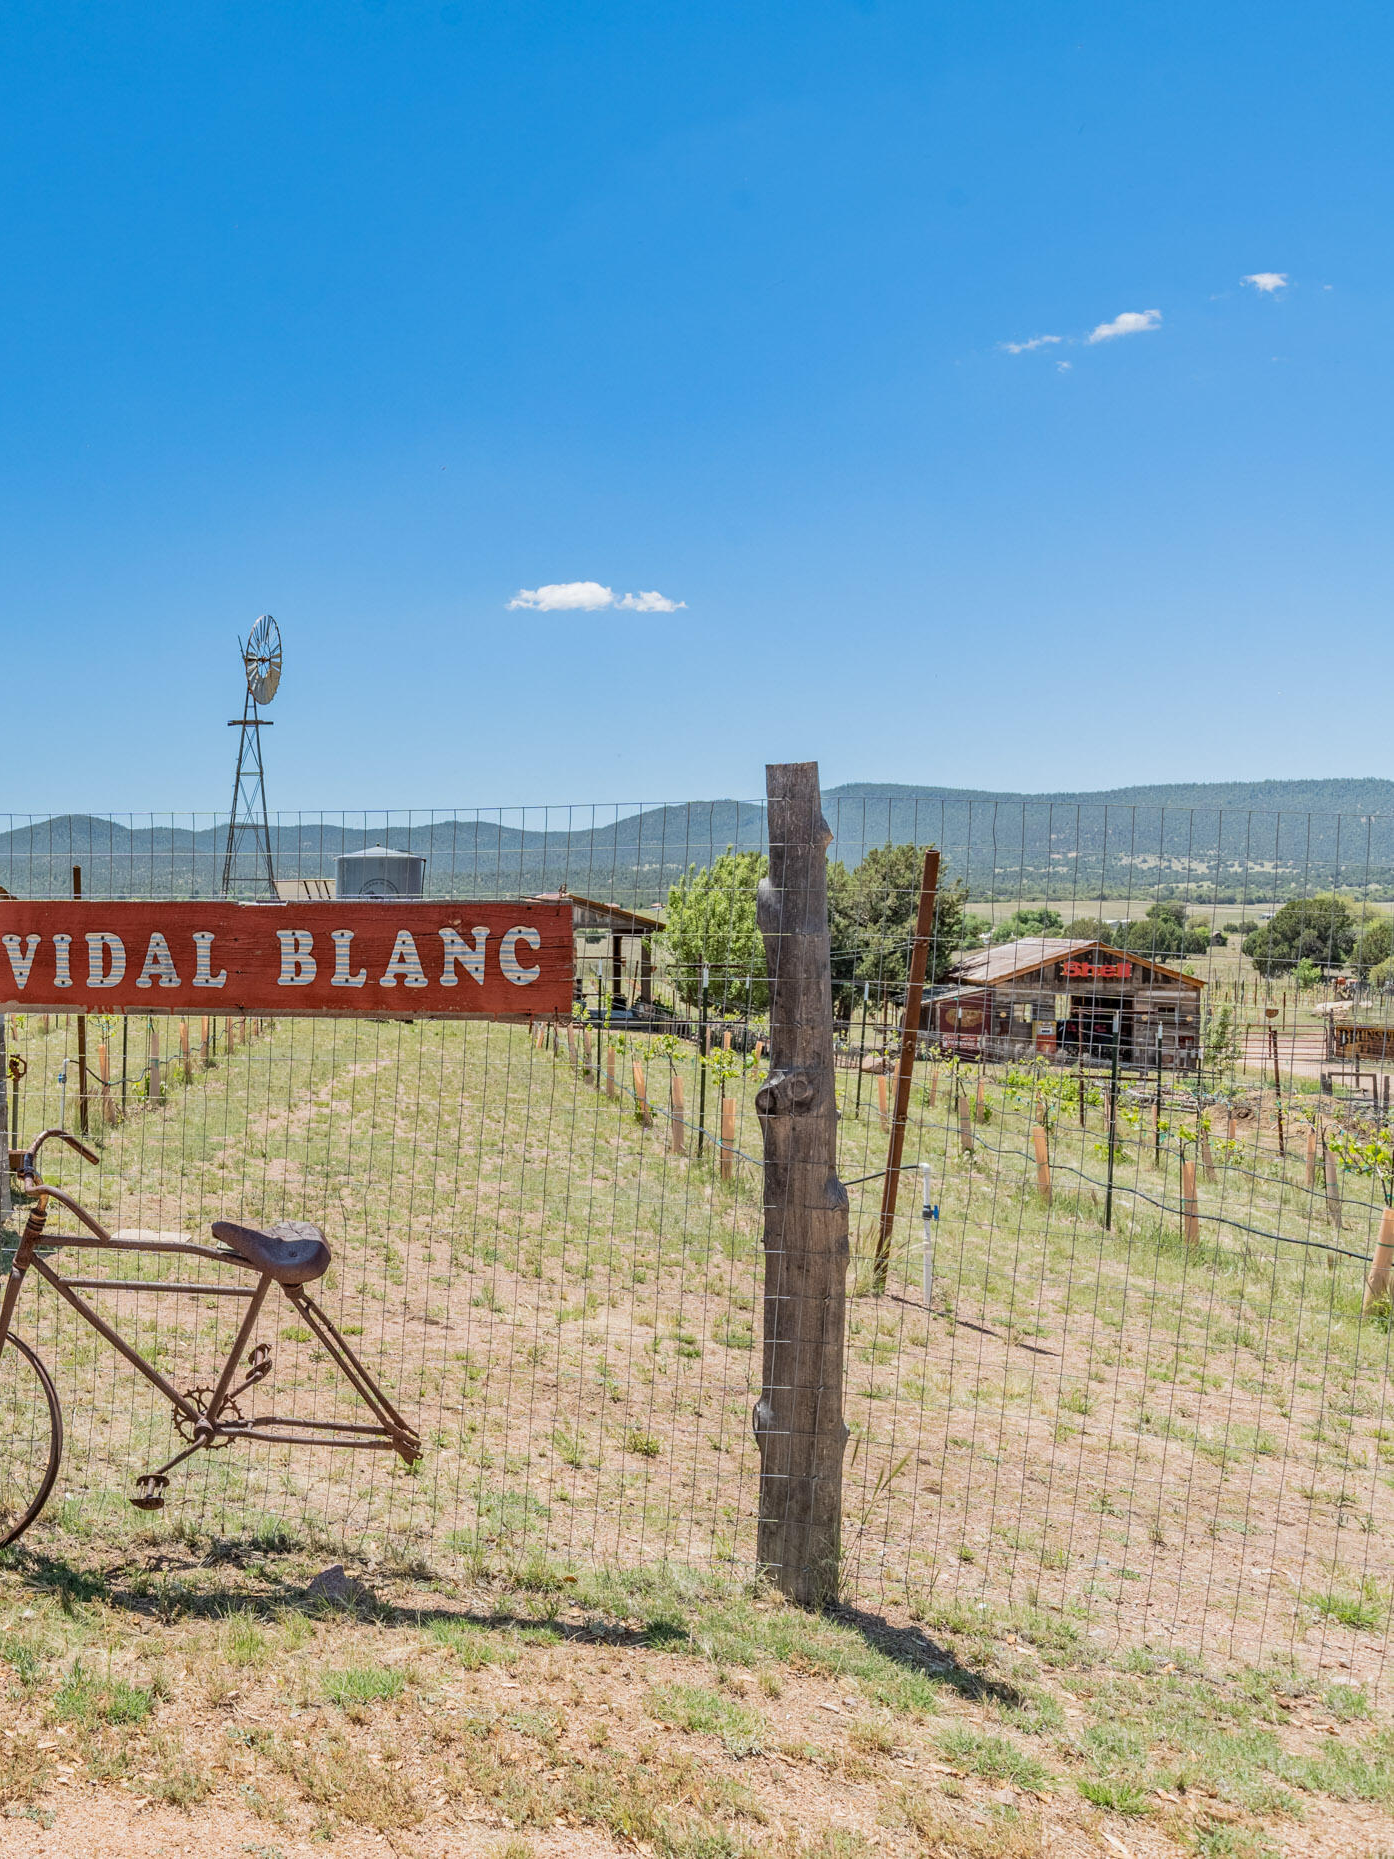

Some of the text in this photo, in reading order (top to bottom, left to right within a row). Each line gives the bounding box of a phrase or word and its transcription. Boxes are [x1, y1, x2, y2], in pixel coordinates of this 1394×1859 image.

[1, 925, 542, 990] VIDAL BLANC
[1062, 961, 1132, 978] Shell
